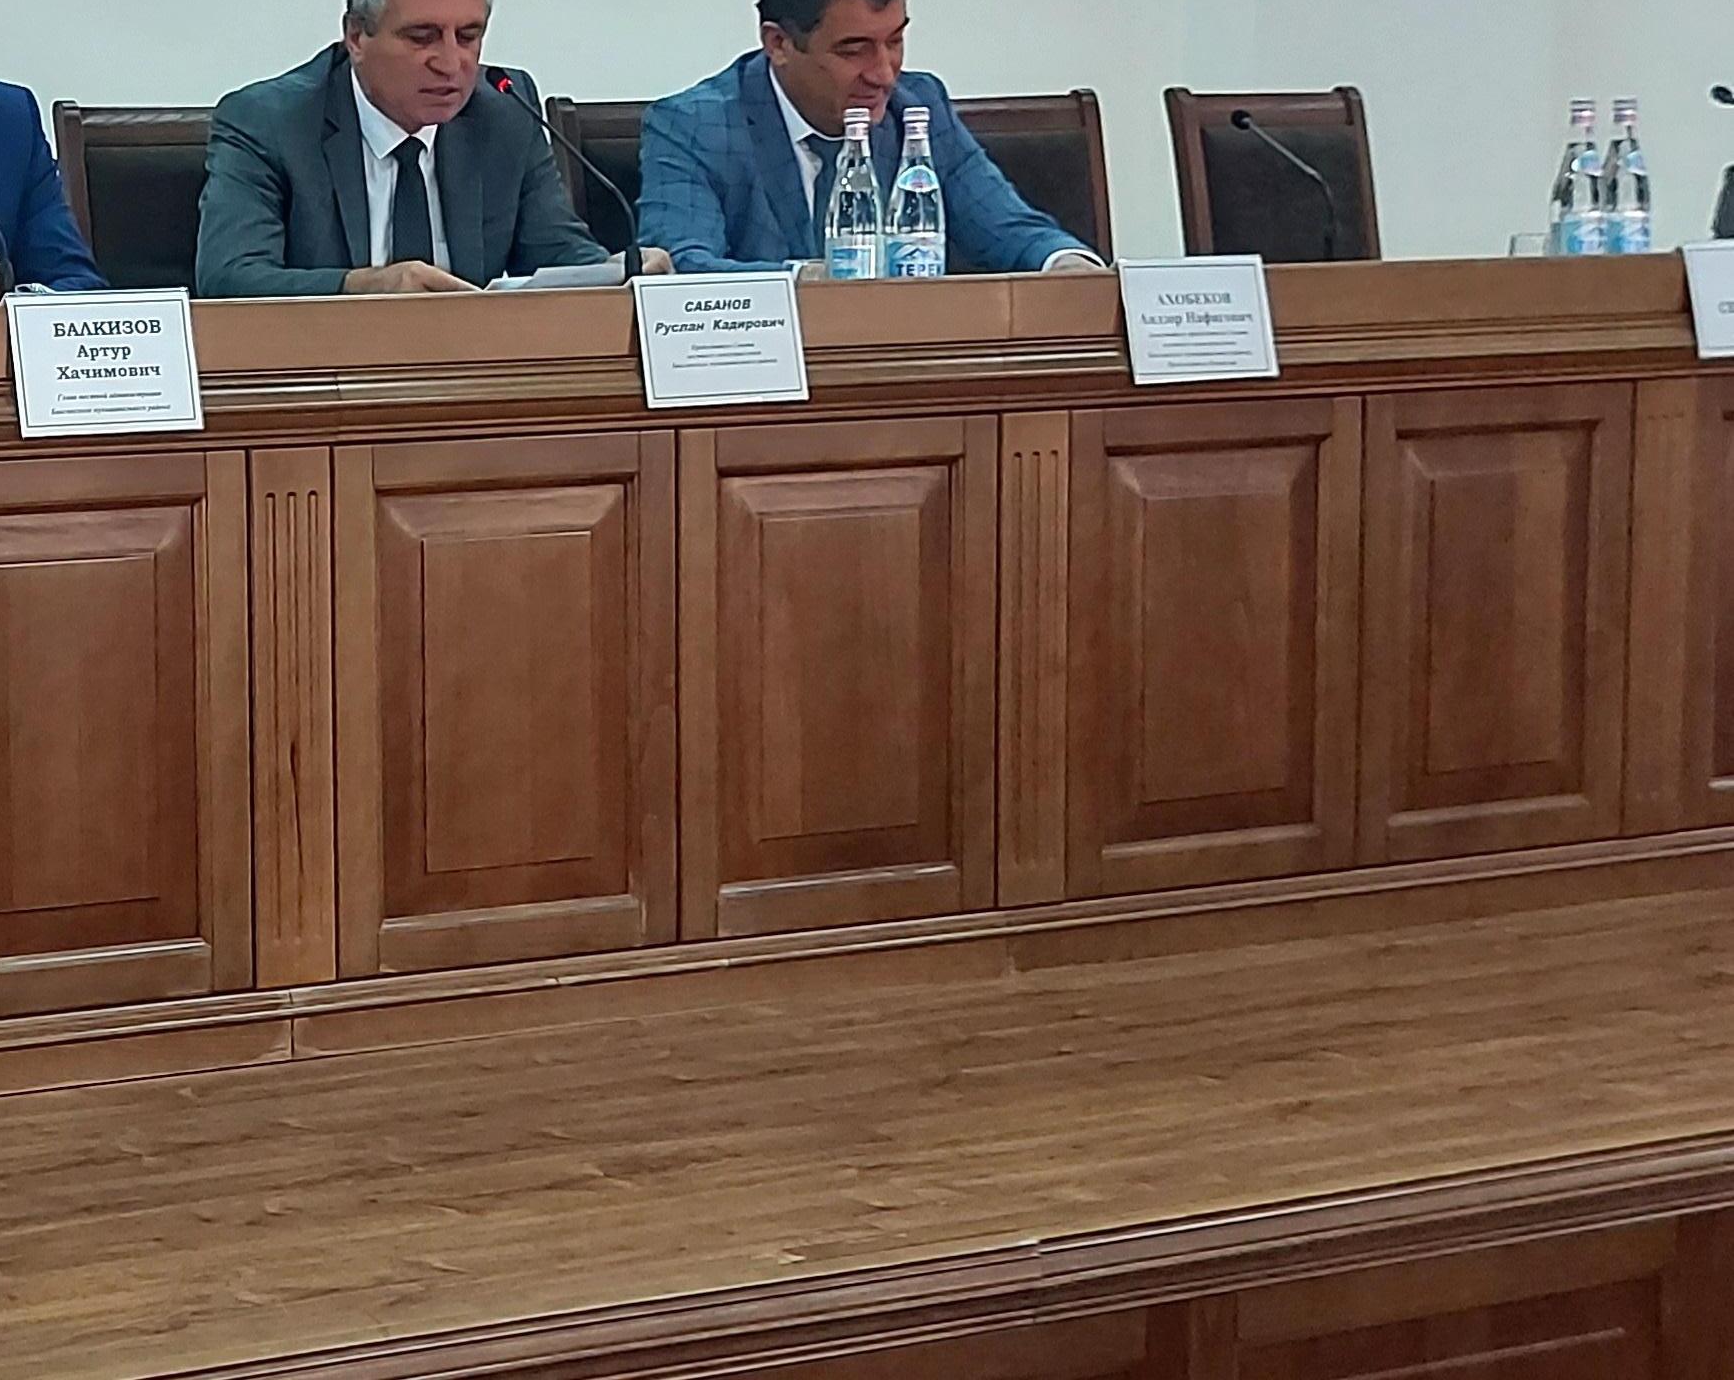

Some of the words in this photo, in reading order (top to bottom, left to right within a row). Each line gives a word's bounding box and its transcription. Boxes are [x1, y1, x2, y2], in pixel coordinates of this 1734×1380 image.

[684, 299, 752, 313] САБАНОВ
[53, 320, 161, 338] БАЛКИЗОВ
[655, 322, 705, 335] Руслан
[713, 318, 785, 331] Кадирович
[77, 345, 131, 361] Артур
[57, 366, 161, 380] Хачимович
